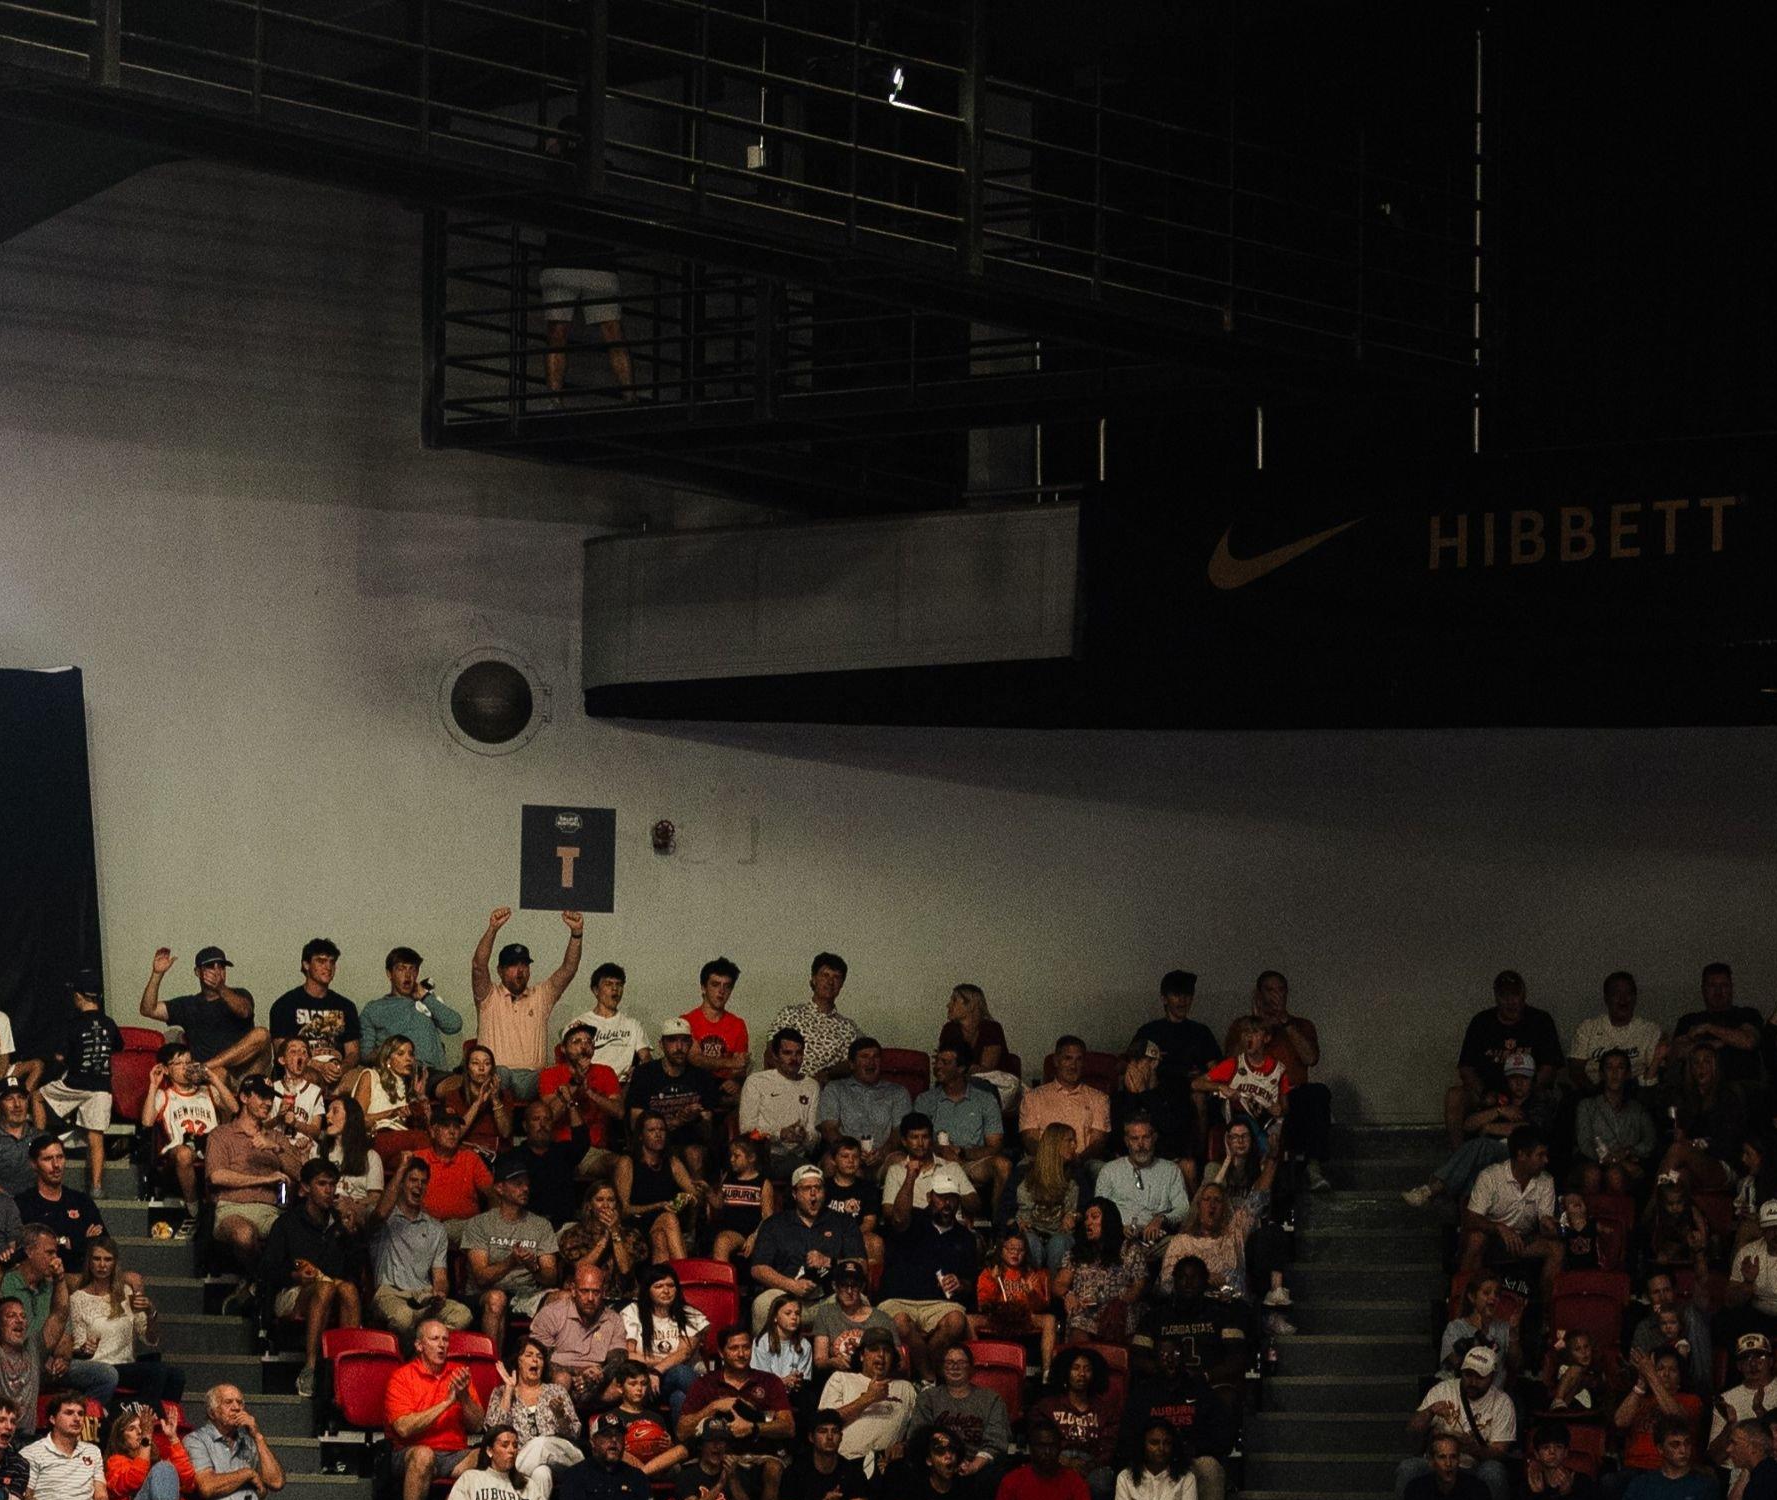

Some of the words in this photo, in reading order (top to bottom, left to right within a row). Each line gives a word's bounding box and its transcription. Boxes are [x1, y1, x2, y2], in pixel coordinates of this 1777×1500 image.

[1428, 496, 1736, 571] HIBBETT
[556, 846, 581, 889] T
[1150, 1404, 1195, 1417] AUBURN
